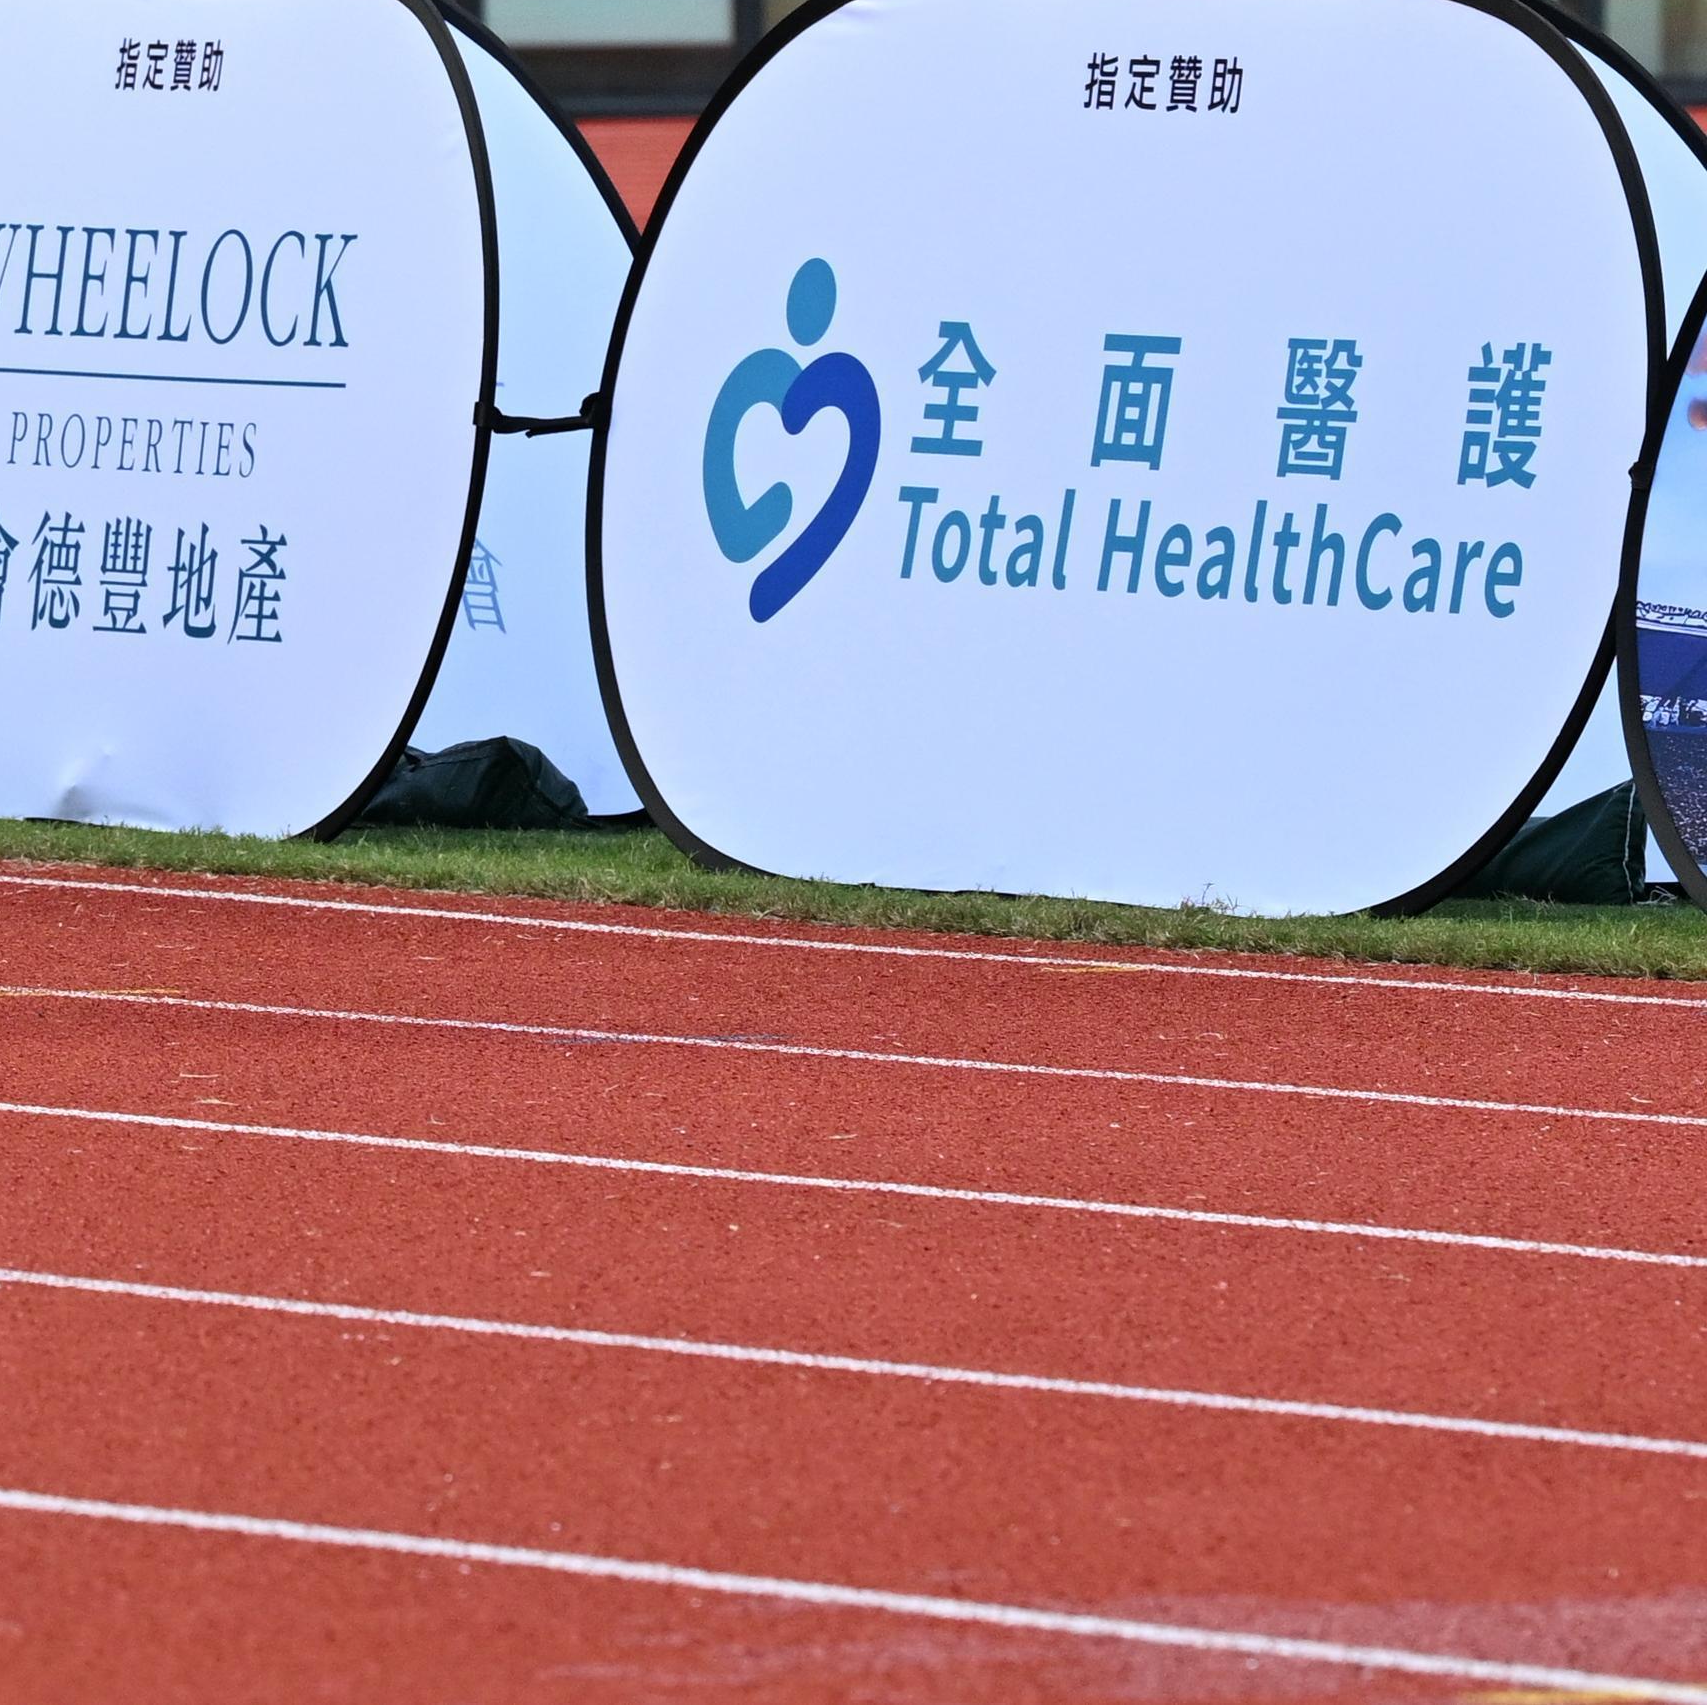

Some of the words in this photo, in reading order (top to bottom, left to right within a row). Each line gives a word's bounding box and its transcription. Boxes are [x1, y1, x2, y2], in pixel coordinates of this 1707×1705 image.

[6, 410, 259, 479] PROPERTIES
[898, 486, 1075, 591] Total
[1096, 498, 1524, 620] HealthCare
